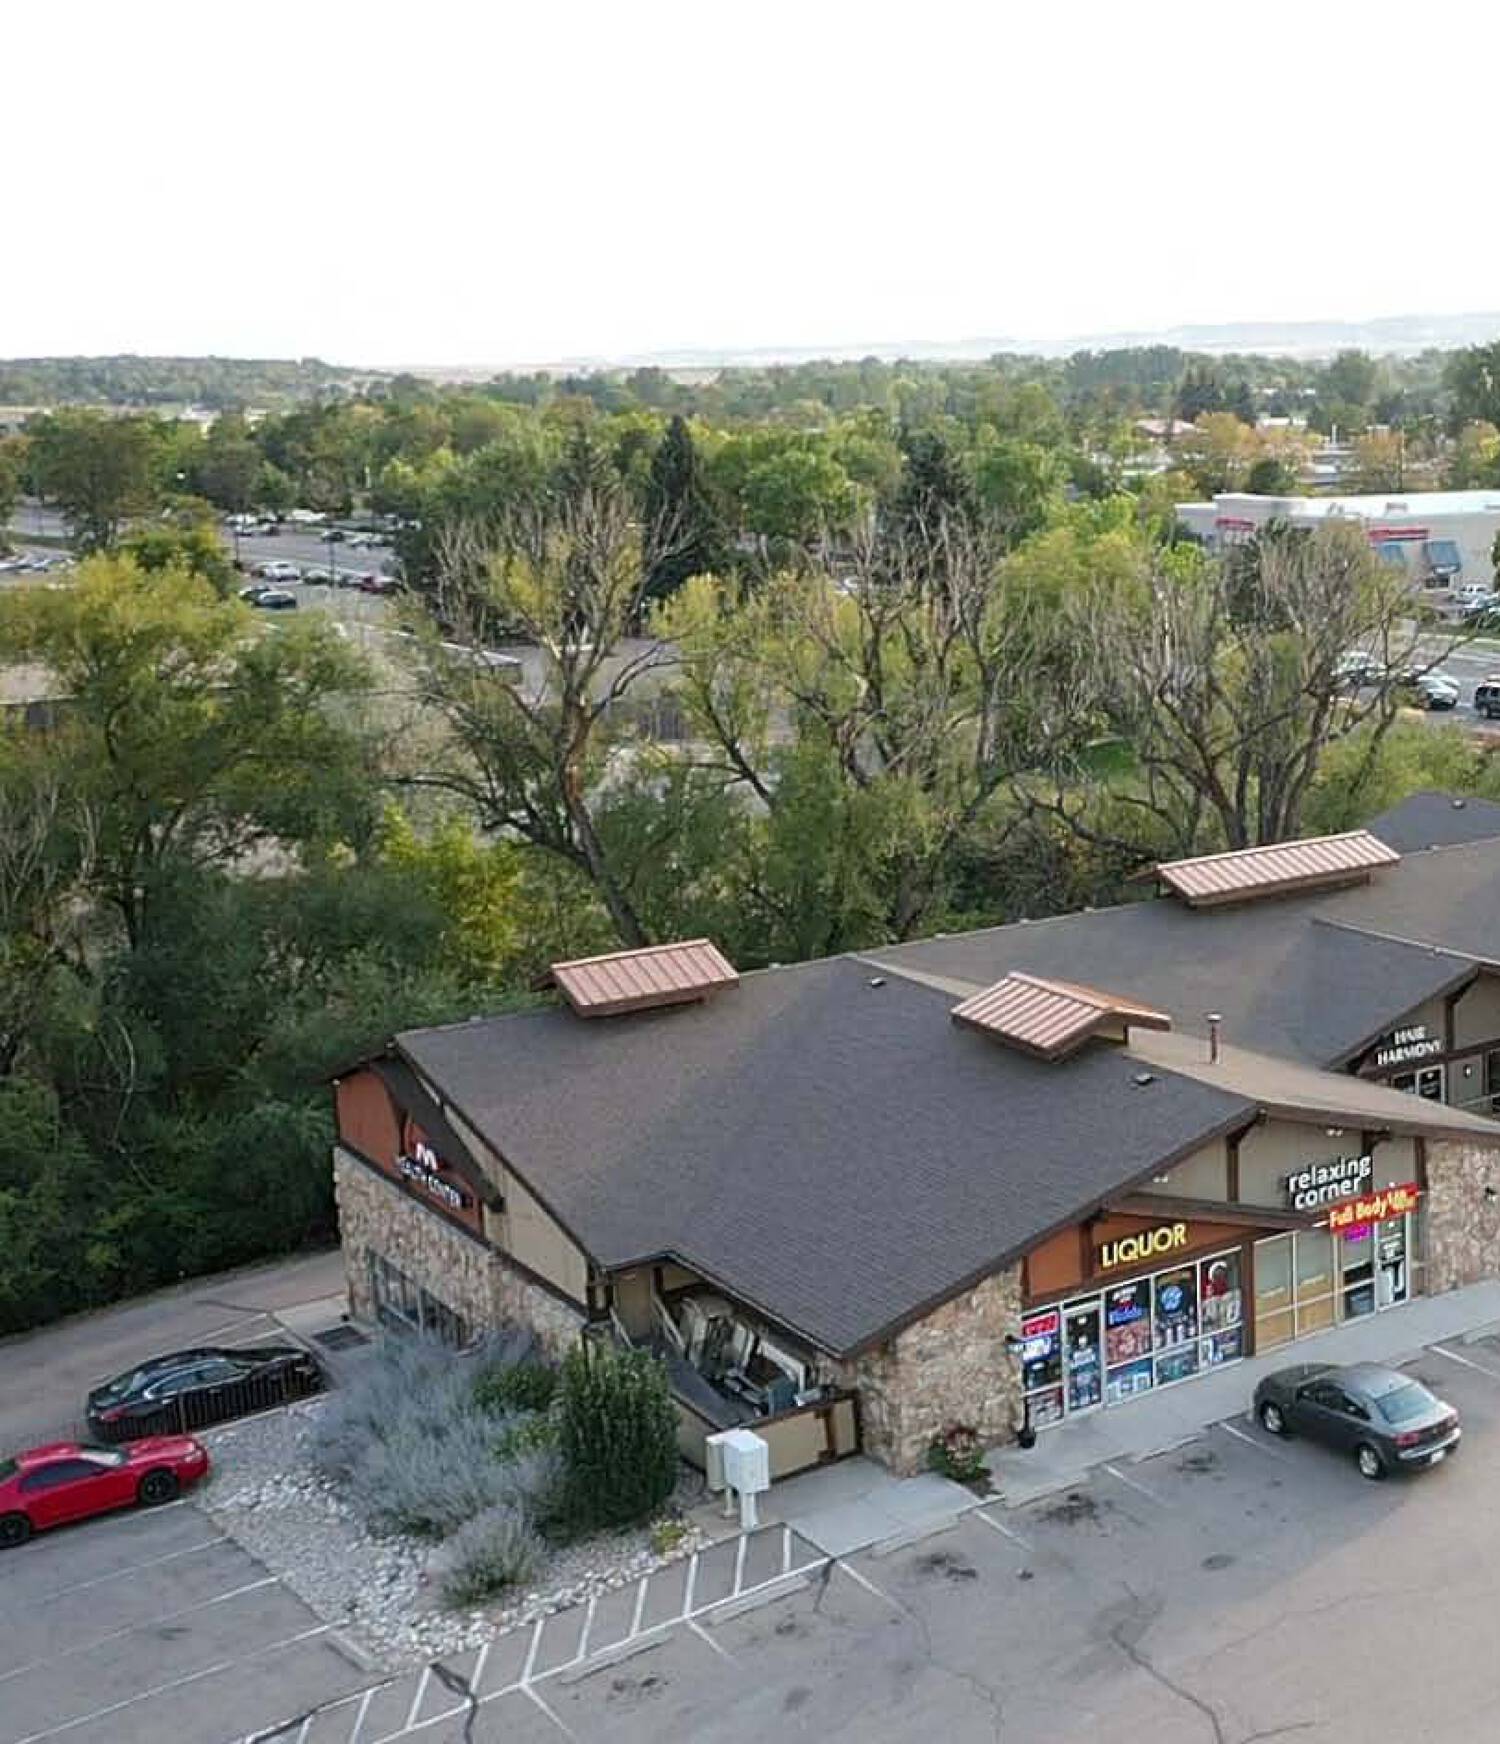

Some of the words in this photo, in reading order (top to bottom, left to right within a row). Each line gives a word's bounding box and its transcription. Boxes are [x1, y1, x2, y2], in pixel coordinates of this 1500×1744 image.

[1377, 1041, 1441, 1065] HARMONY
[1288, 1155, 1371, 1193] relaxing
[1294, 1176, 1361, 1210] corner
[1355, 1195, 1388, 1218] Body
[1102, 1223, 1187, 1267] LIQUOR
